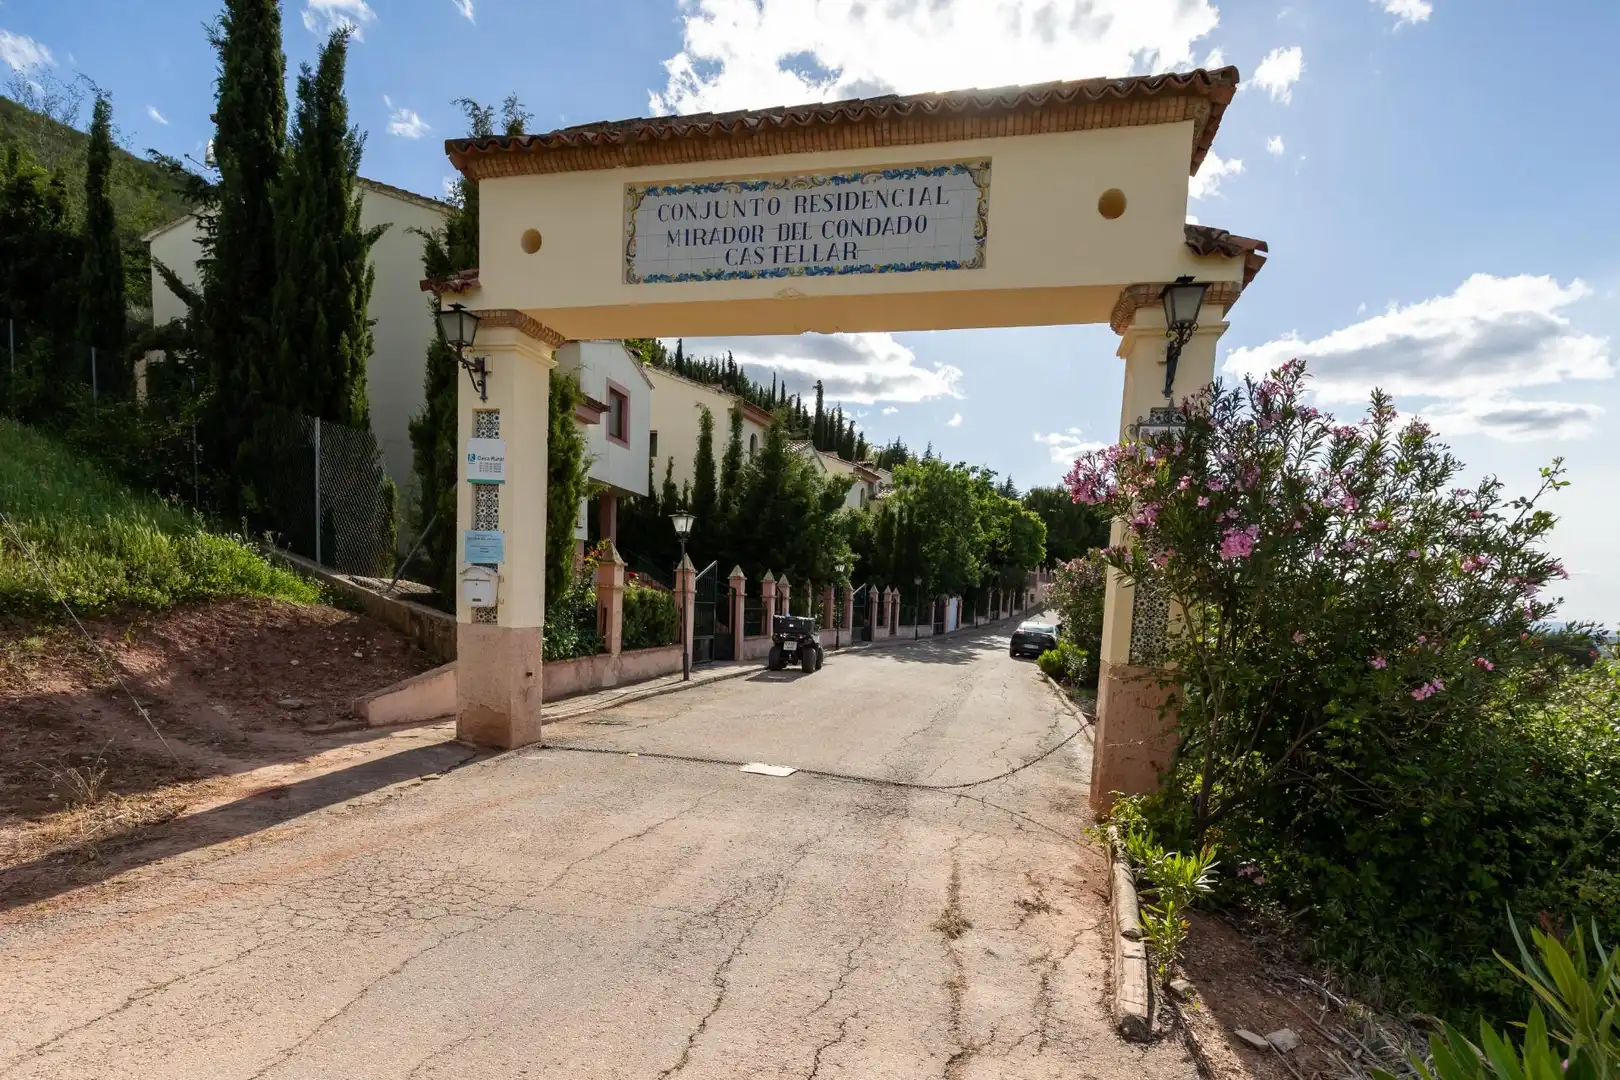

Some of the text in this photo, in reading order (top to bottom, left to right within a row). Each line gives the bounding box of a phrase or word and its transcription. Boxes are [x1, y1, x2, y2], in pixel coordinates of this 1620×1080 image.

[658, 185, 949, 222] CONJUNTO RESIDENCIAL
[666, 214, 927, 247] MIRADOR DEL CONDADO
[725, 241, 858, 267] CASTELLAR
